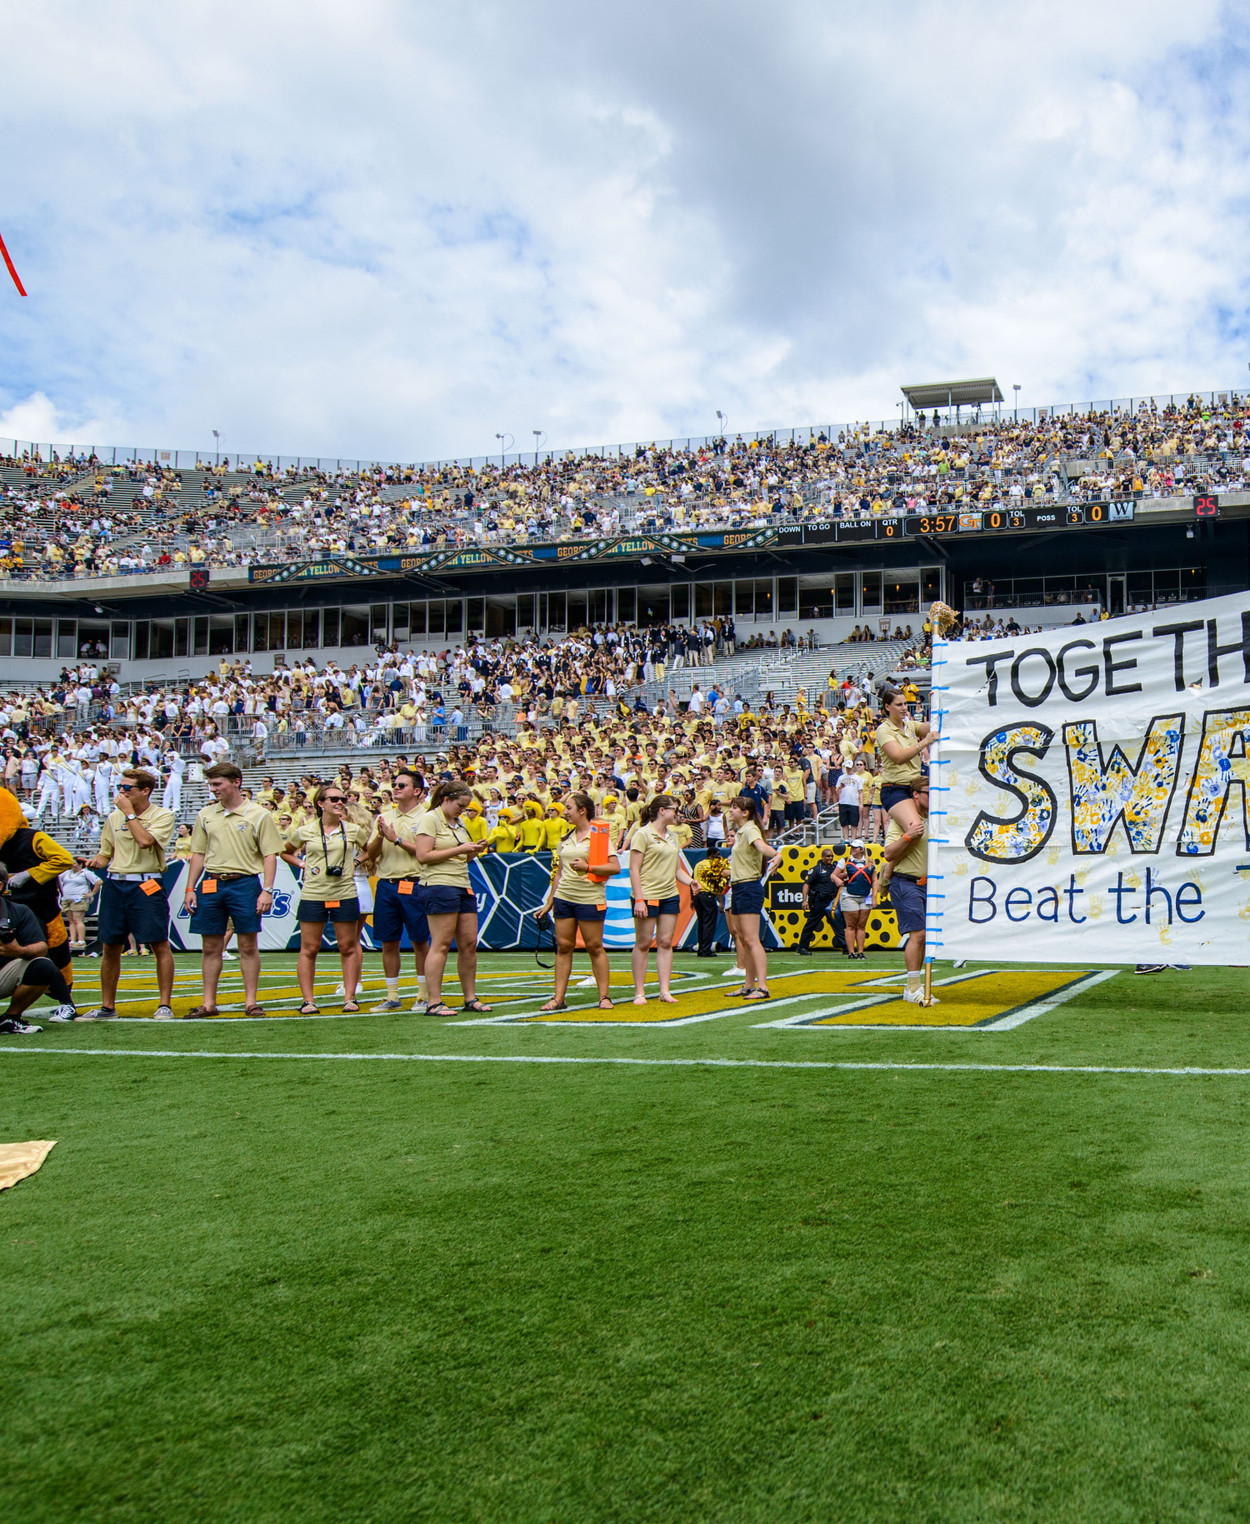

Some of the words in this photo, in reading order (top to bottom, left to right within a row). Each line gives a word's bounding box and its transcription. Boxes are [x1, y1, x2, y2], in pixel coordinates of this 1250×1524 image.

[1110, 502, 1133, 516] W
[1196, 497, 1216, 515] 25
[1071, 513, 1078, 522] 3
[1091, 506, 1102, 521] 0
[807, 523, 818, 531] TO
[819, 522, 831, 531] GO
[839, 520, 859, 529] BALL
[860, 519, 872, 528] ON
[882, 518, 898, 526] QTR
[919, 515, 955, 533] 3:57
[959, 514, 982, 529] GT
[990, 513, 1001, 528] 0
[1013, 517, 1020, 526] 3
[778, 526, 801, 534] DOWN
[886, 526, 894, 537] 0
[621, 540, 655, 553] YELLOW
[461, 553, 493, 565] YELLOW
[310, 564, 341, 576] YELLOW
[191, 572, 205, 587] 25
[777, 888, 804, 903] the
[968, 875, 1088, 925] Beat
[1107, 866, 1206, 926] the
